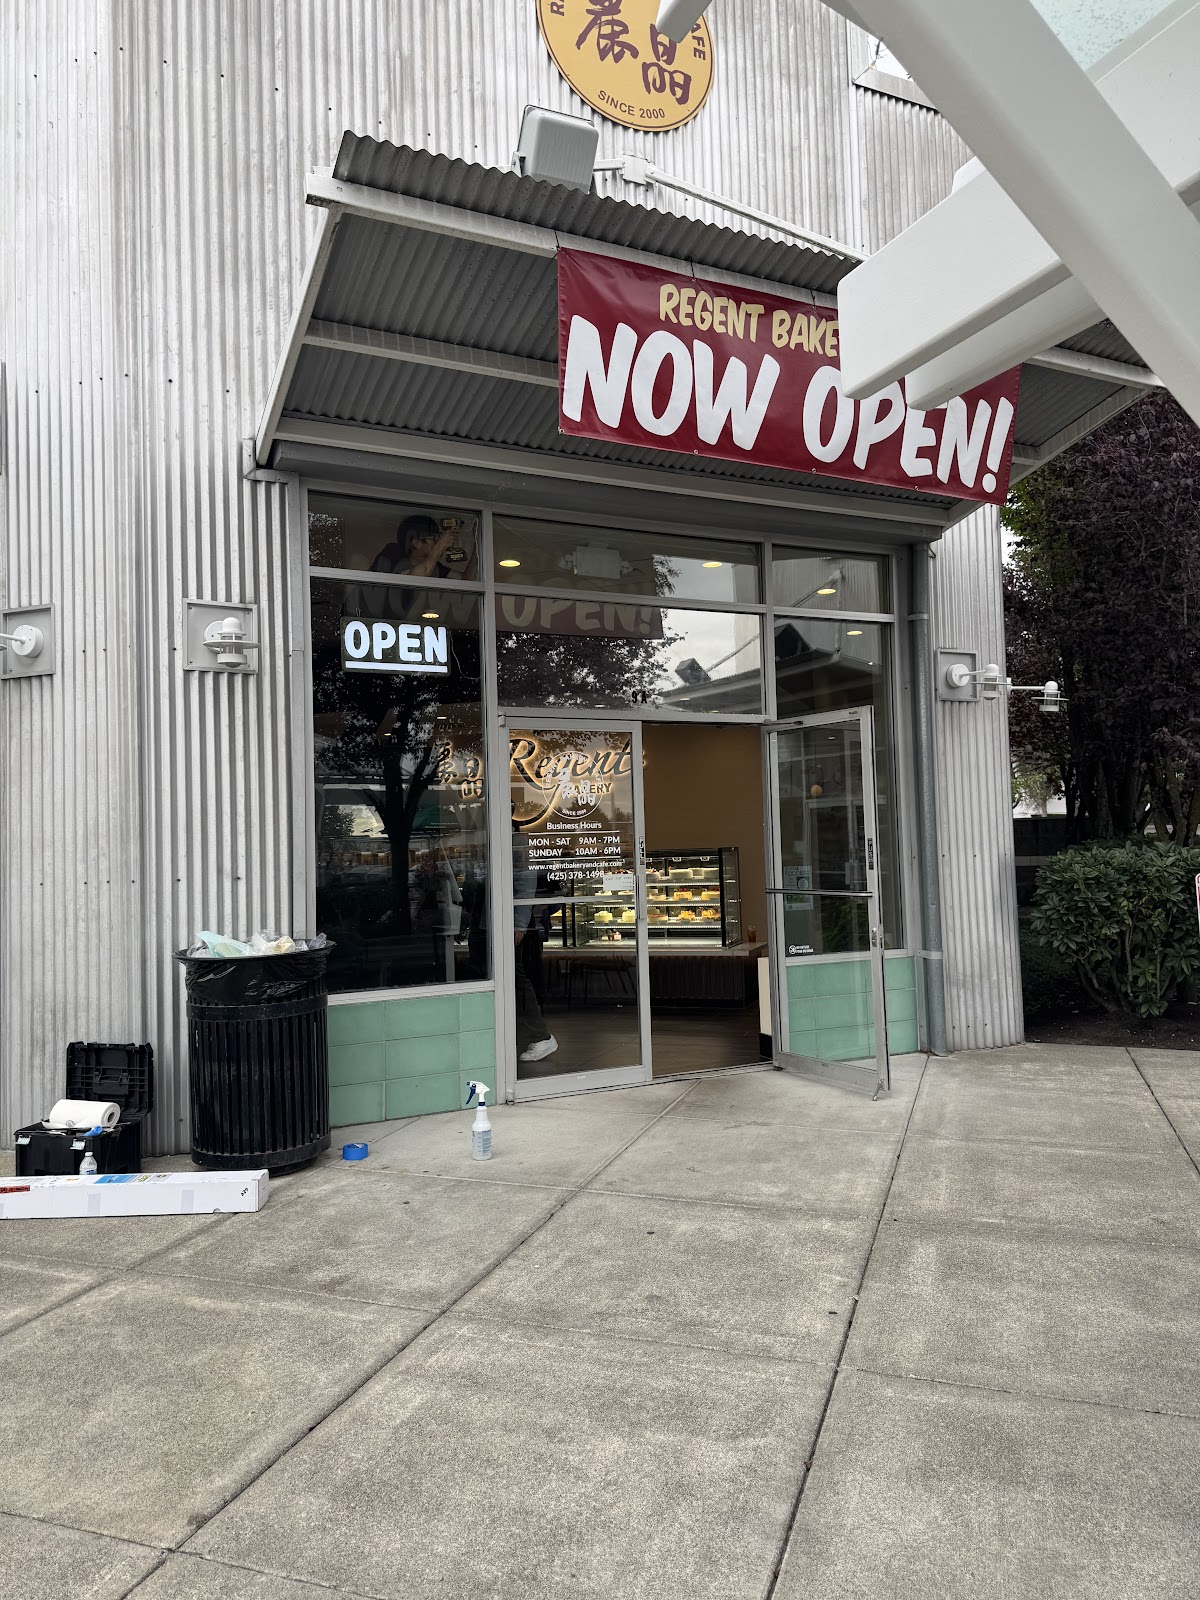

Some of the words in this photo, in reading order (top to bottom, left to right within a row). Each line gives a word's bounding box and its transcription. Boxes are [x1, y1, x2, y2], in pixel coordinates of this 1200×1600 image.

[690, 22, 706, 61] AFE
[598, 90, 635, 116] SINCE
[639, 108, 666, 119] 2000
[659, 283, 765, 343] REGENT
[772, 309, 839, 358] BAKE
[562, 314, 781, 451] NOW
[803, 365, 1014, 493] OPEN!
[344, 620, 447, 663] OPEN
[509, 738, 633, 827] Regent
[567, 782, 612, 795] AERY
[547, 822, 578, 830] Business
[580, 821, 602, 829] Hours
[528, 838, 549, 846] MON
[556, 837, 571, 846] SAT
[578, 836, 597, 845] 9AM
[603, 836, 620, 844] 7PM
[528, 848, 563, 857] SUNDAY
[575, 847, 598, 856] 10AM
[604, 846, 621, 855] 6PM
[528, 861, 622, 871] www.regentbakeryandcafe.com
[547, 871, 567, 882] (425)
[568, 870, 605, 879] 378-1498
